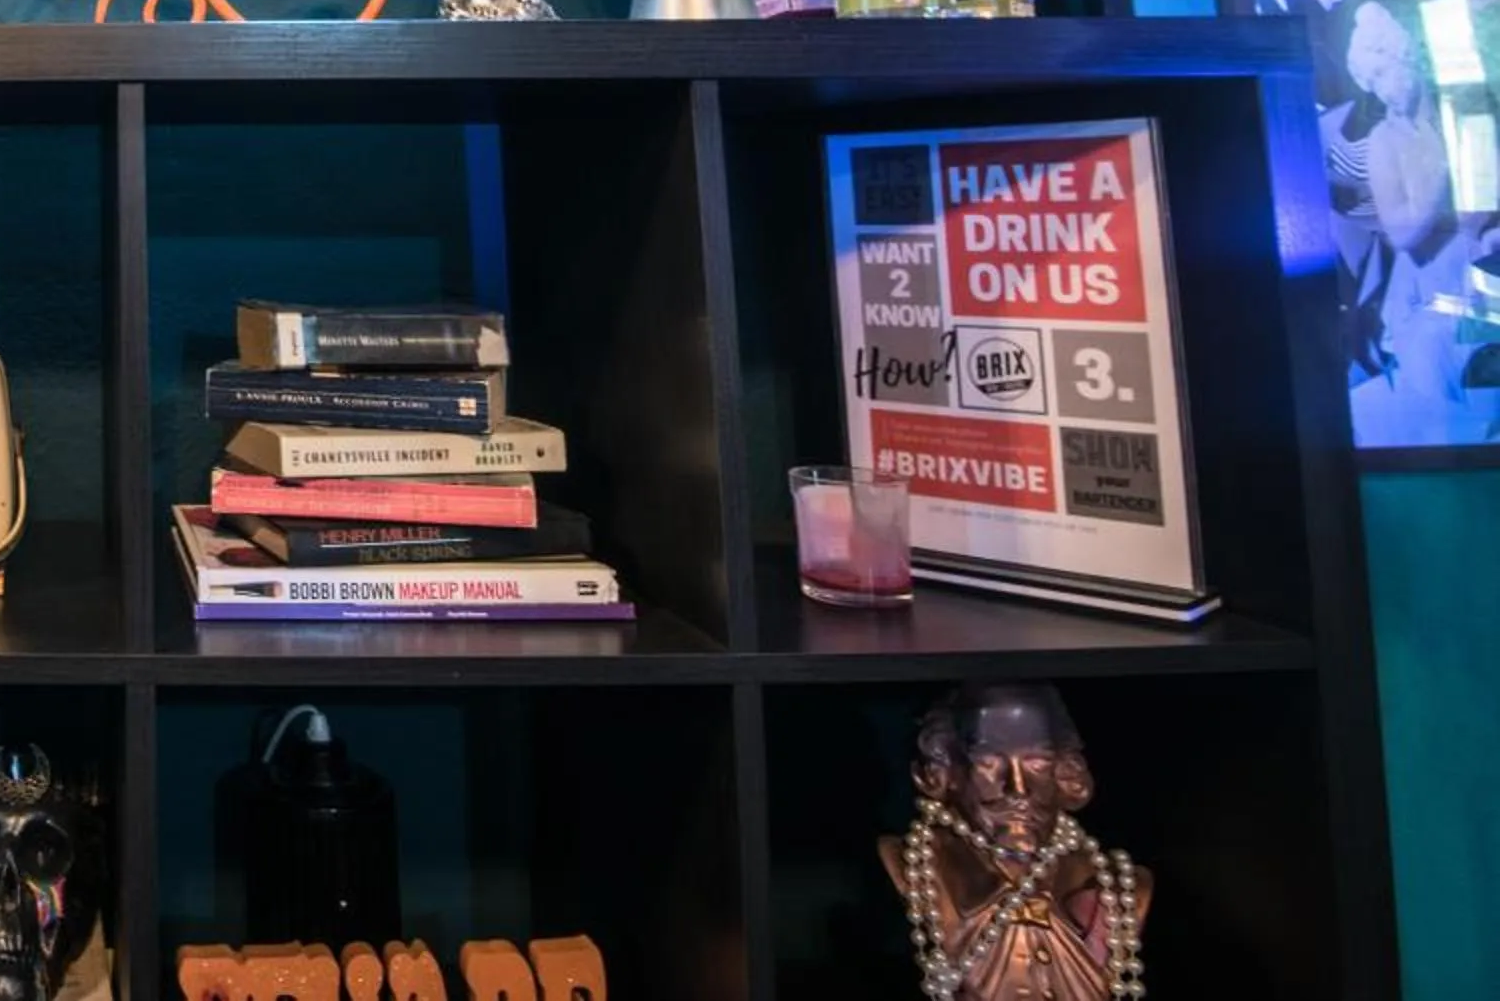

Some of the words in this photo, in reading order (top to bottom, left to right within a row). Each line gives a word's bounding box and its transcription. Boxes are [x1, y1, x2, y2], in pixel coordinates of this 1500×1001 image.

[948, 162, 1077, 205] HAVE
[1090, 160, 1127, 201] A
[963, 212, 1117, 253] DRINK
[861, 241, 935, 265] WANT
[890, 269, 912, 298] 2
[968, 263, 1038, 302] ON
[1049, 264, 1120, 306] US
[864, 304, 940, 329] KNOW
[855, 331, 958, 399] How?
[976, 349, 1027, 381] BRIX
[1073, 348, 1135, 403] 3.
[396, 448, 450, 462] INCIDENT
[875, 448, 1049, 496] #BRIXVIBE
[319, 529, 376, 544] HENRY
[381, 526, 442, 542] MILLER
[289, 582, 335, 600] BOBBI
[340, 582, 395, 600] BROWN
[400, 581, 459, 599] MAKEUP
[463, 580, 524, 599] MANUAL
